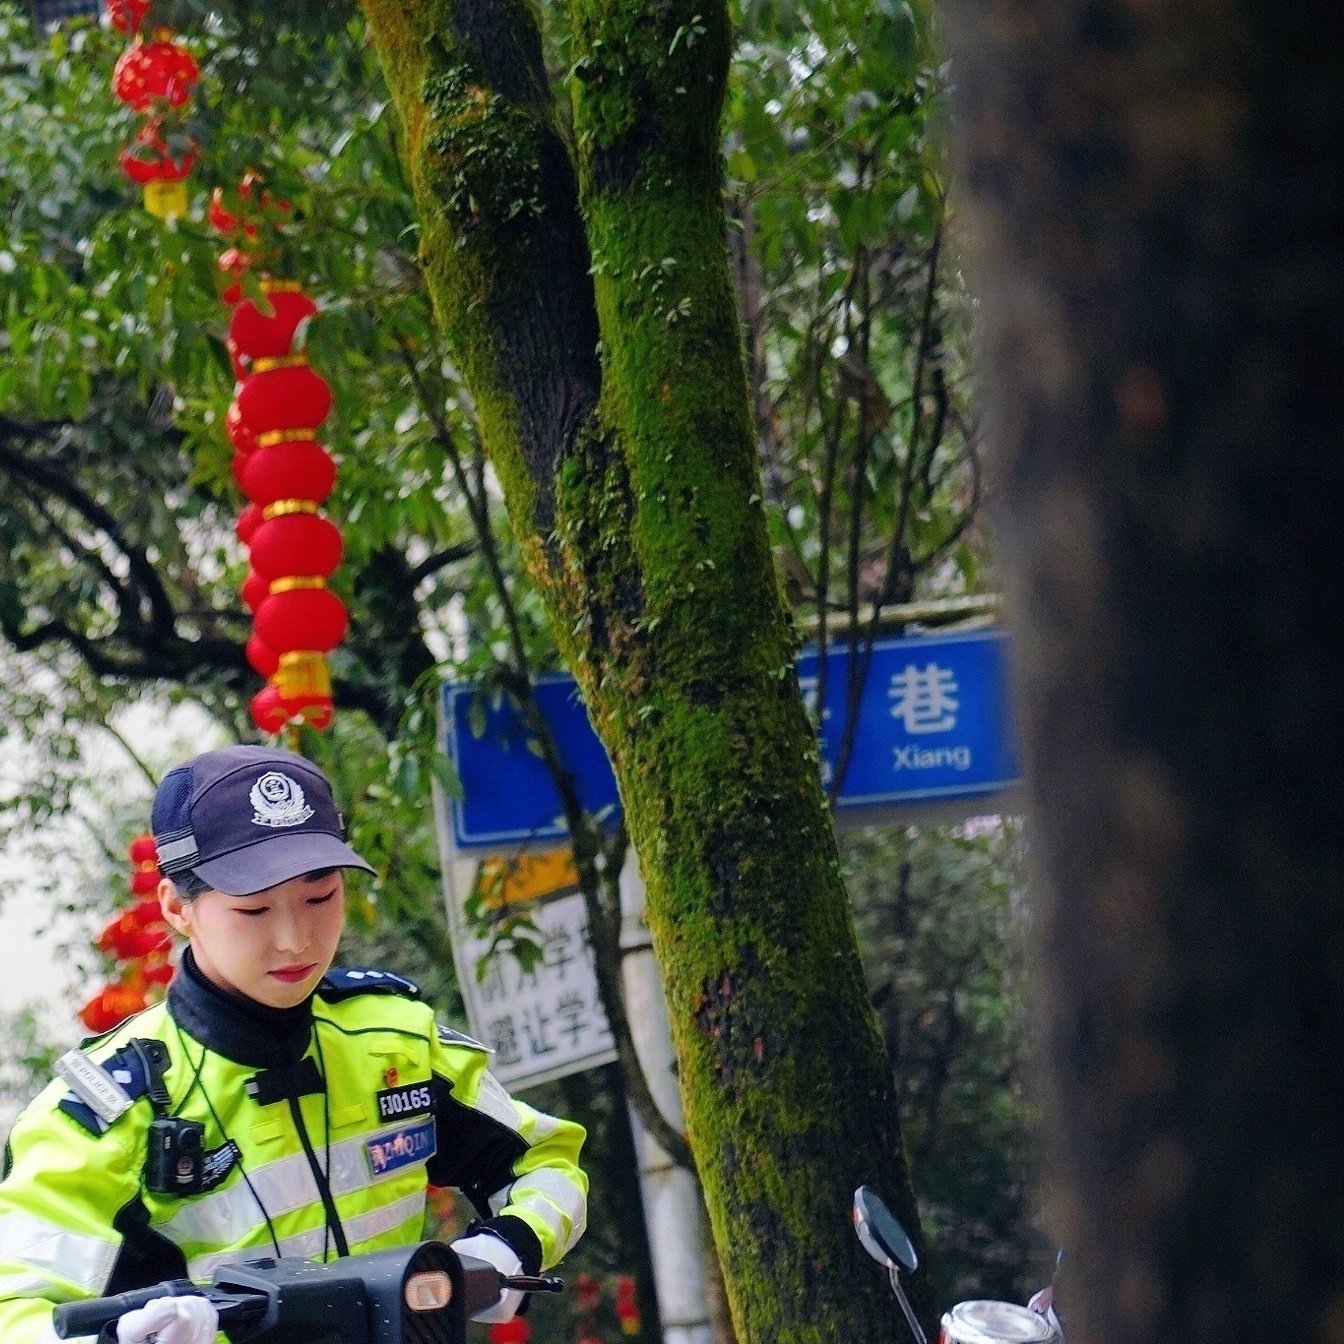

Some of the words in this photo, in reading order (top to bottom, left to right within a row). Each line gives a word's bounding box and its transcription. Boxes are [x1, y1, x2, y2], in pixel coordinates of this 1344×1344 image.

[887, 662, 960, 734] 巷
[893, 745, 971, 771] Xiang
[379, 1087, 431, 1116] FJ0165
